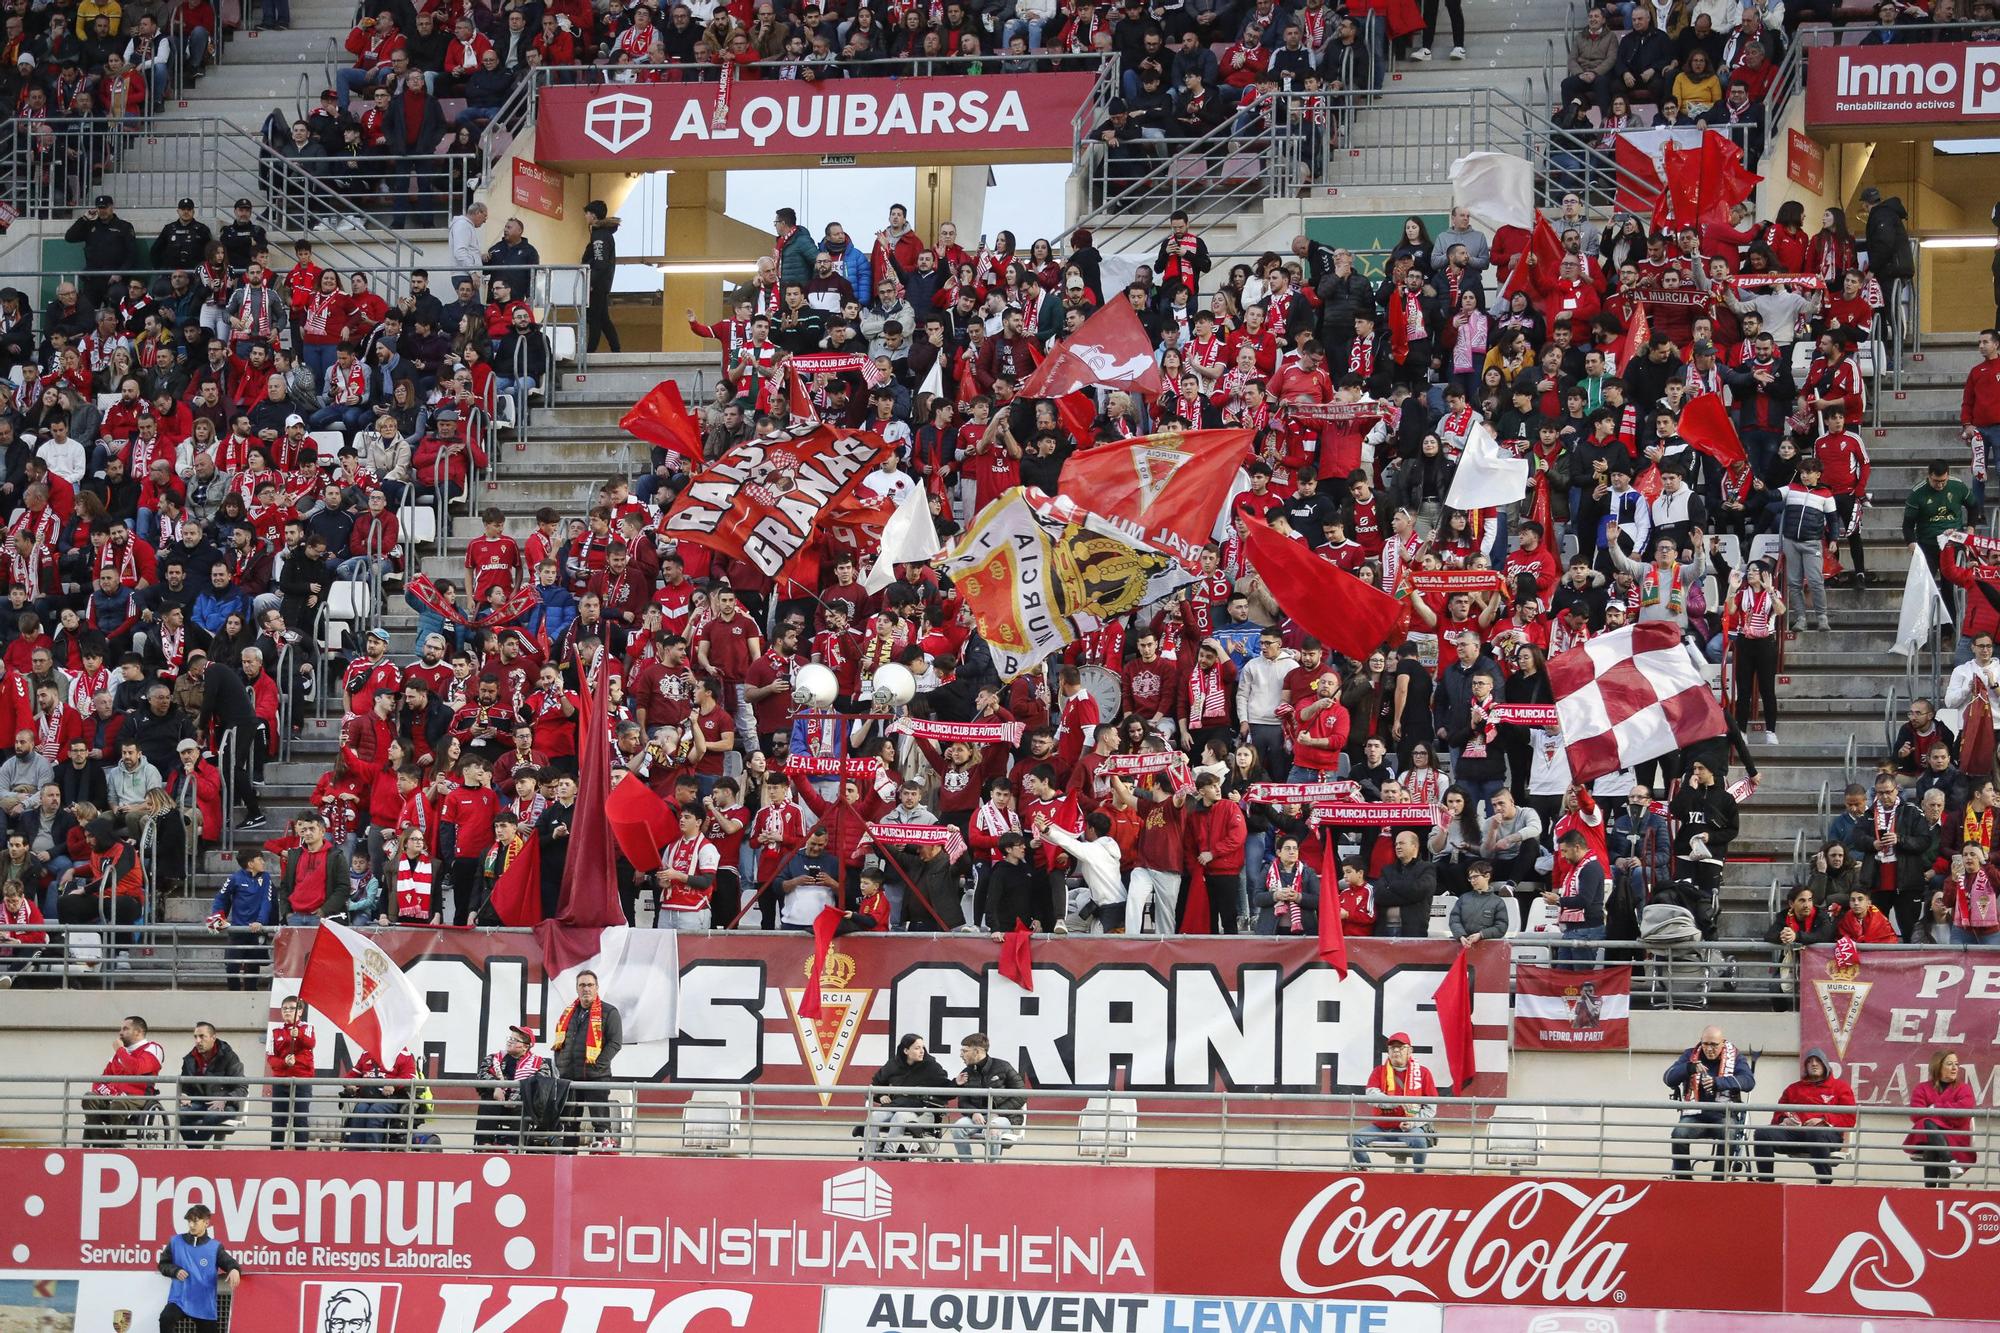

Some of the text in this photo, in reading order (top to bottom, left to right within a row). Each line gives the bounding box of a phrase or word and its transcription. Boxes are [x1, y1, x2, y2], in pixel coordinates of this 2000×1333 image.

[1837, 56, 1957, 96] Inmo
[1836, 100, 1955, 111] Rentabilizando activos
[1650, 292, 1690, 303] MURCIA
[792, 360, 819, 368] MURCIA
[820, 359, 837, 367] CLUB
[1413, 575, 1496, 584] REAL MURCIA
[1495, 708, 1514, 717] REAL
[1515, 709, 1546, 718] MURCIA
[911, 720, 1002, 736] REAL MURCIA CLUB DE FÚTBOL
[787, 757, 815, 769] REAL
[817, 758, 864, 772] MURCIA
[1116, 756, 1136, 767] REAL
[1270, 782, 1350, 796] REAL MURCIA
[1315, 806, 1431, 818] REAL MURCIA CLUB DE FÚTBOL
[880, 827, 905, 837] MURCIA
[905, 829, 921, 838] CLUB
[922, 829, 931, 839] DE
[822, 994, 852, 1002] RCIA
[1843, 994, 1862, 1033] FUTBOL
[890, 961, 1474, 1094] GRANAS
[1885, 1008, 1965, 1044] EL
[800, 1016, 824, 1071] CLU
[829, 1009, 858, 1071] FUTBOL
[1549, 1030, 1572, 1043] PEDRO,
[1573, 1031, 1583, 1041] NO
[80, 1153, 472, 1246] Prevemur
[1978, 1214, 1999, 1222] 1870
[1978, 1223, 1999, 1232] 2020
[1280, 1176, 1651, 1303] Coca-Cola
[80, 1243, 151, 1264] Servicio
[286, 1247, 307, 1267] de
[312, 1246, 380, 1270] Riesgos
[385, 1249, 472, 1270] Laborales
[866, 1293, 1388, 1333] ALQUIVENT LEVANTE
